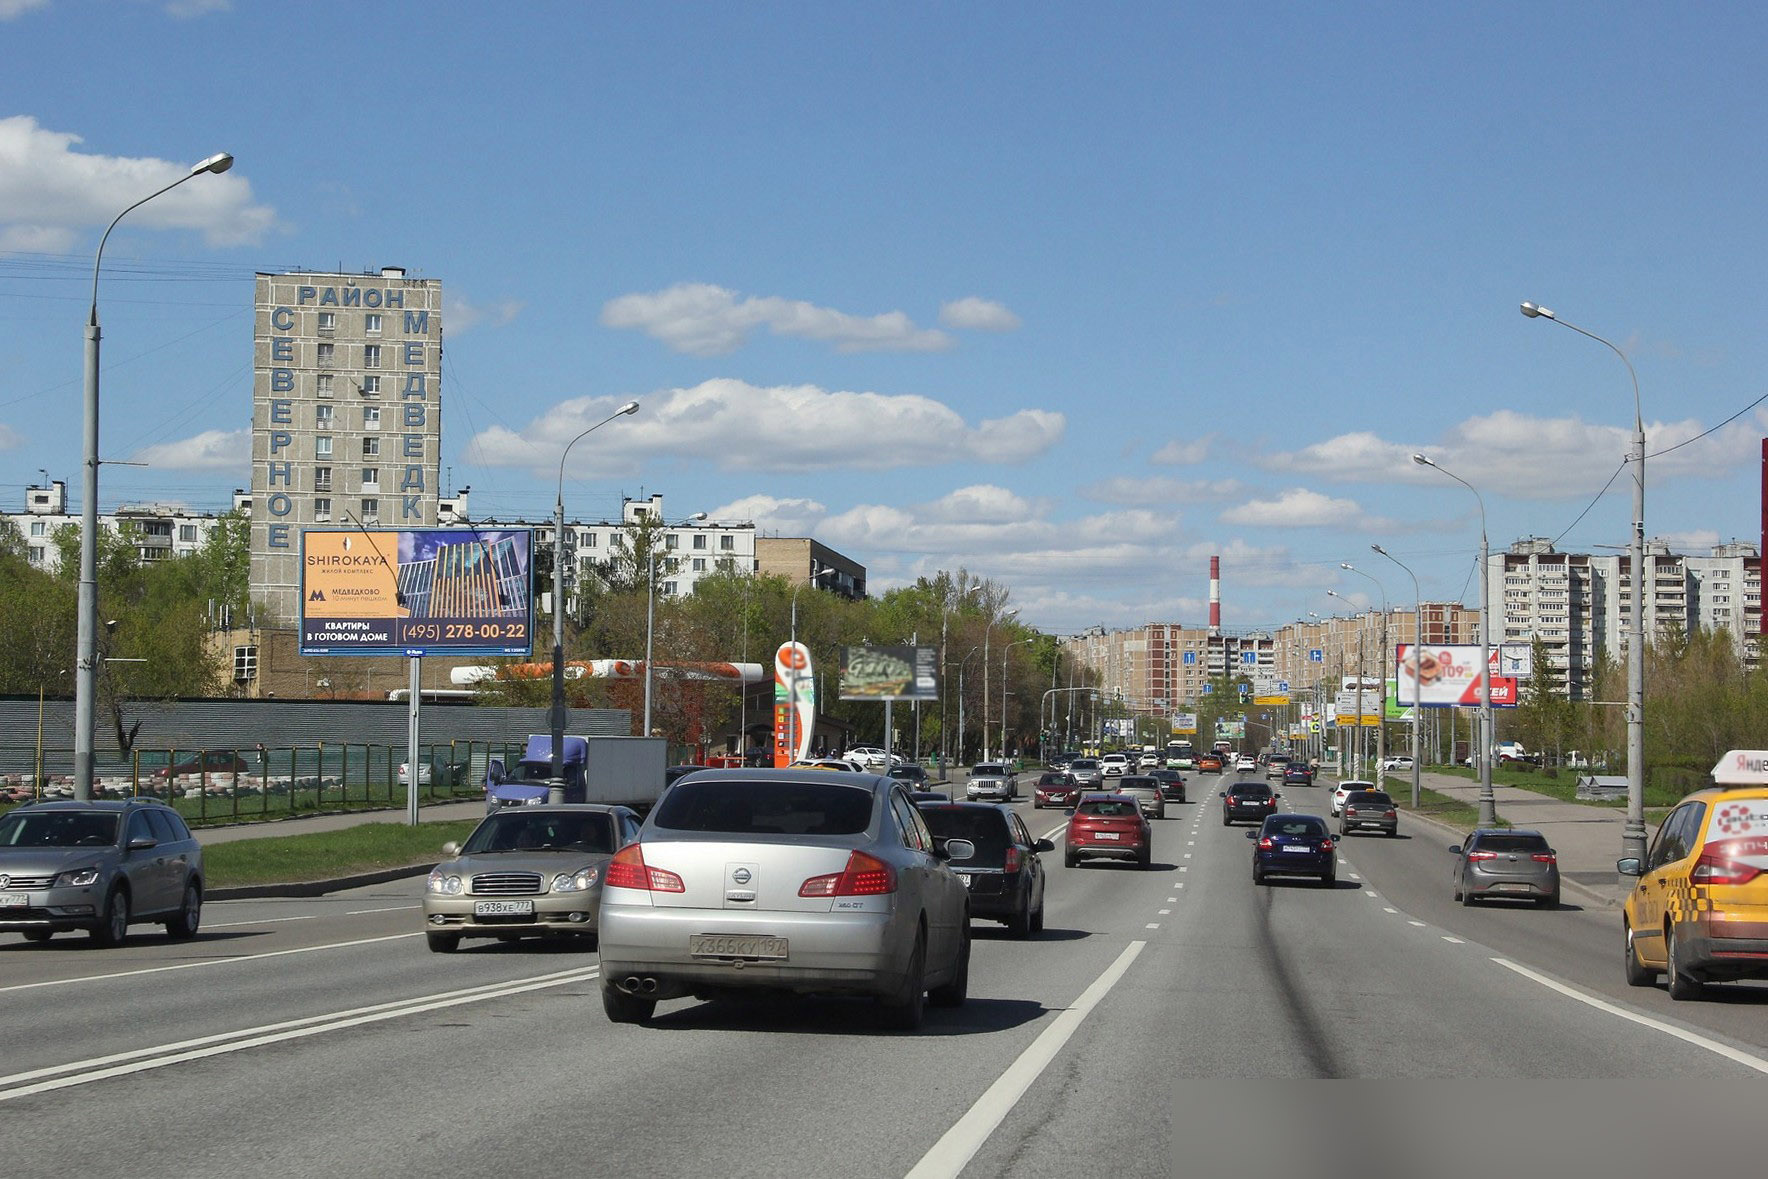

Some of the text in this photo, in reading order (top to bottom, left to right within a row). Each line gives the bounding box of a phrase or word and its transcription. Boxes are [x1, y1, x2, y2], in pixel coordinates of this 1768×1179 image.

[299, 281, 404, 308] РАЙОН
[268, 306, 294, 547] СЕВЕРНОЕ
[307, 555, 389, 566] SHIROKAYA
[331, 588, 380, 596] МЕДВЕДКОВО
[325, 622, 370, 631] КВАРТИРЫ
[306, 633, 388, 642] В ГОТОВОМ ДОМЕ
[402, 624, 525, 642] (495) 278-00-22
